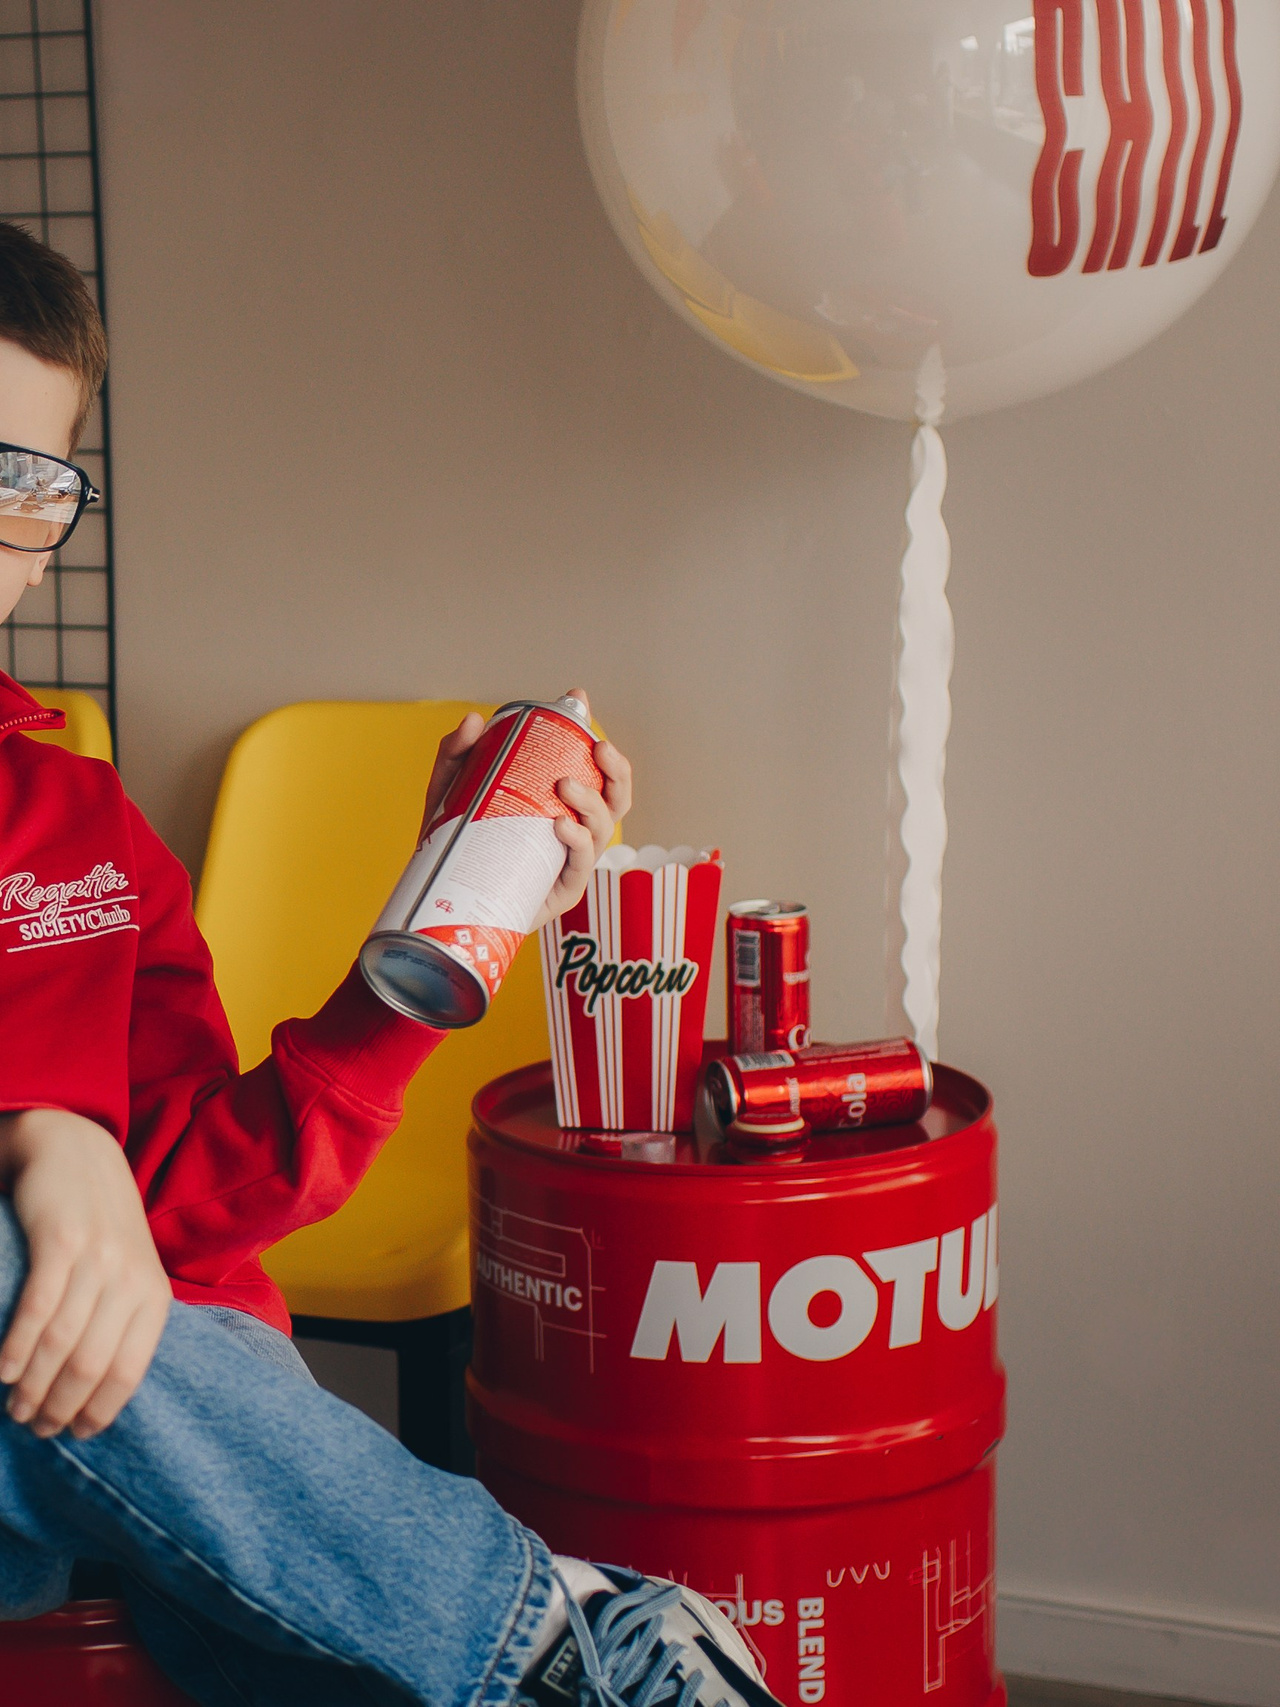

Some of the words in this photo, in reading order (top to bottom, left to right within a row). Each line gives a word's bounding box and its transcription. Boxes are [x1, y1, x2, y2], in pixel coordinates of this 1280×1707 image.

[1027, 0, 1242, 278] CHILL
[19, 912, 87, 941] SOCIETY
[86, 904, 131, 930] Club
[554, 933, 696, 1014] Popcorn
[477, 1250, 583, 1312] AUTHENTIC
[629, 1202, 1000, 1364] MOTUL
[797, 1596, 825, 1704] BLEND
